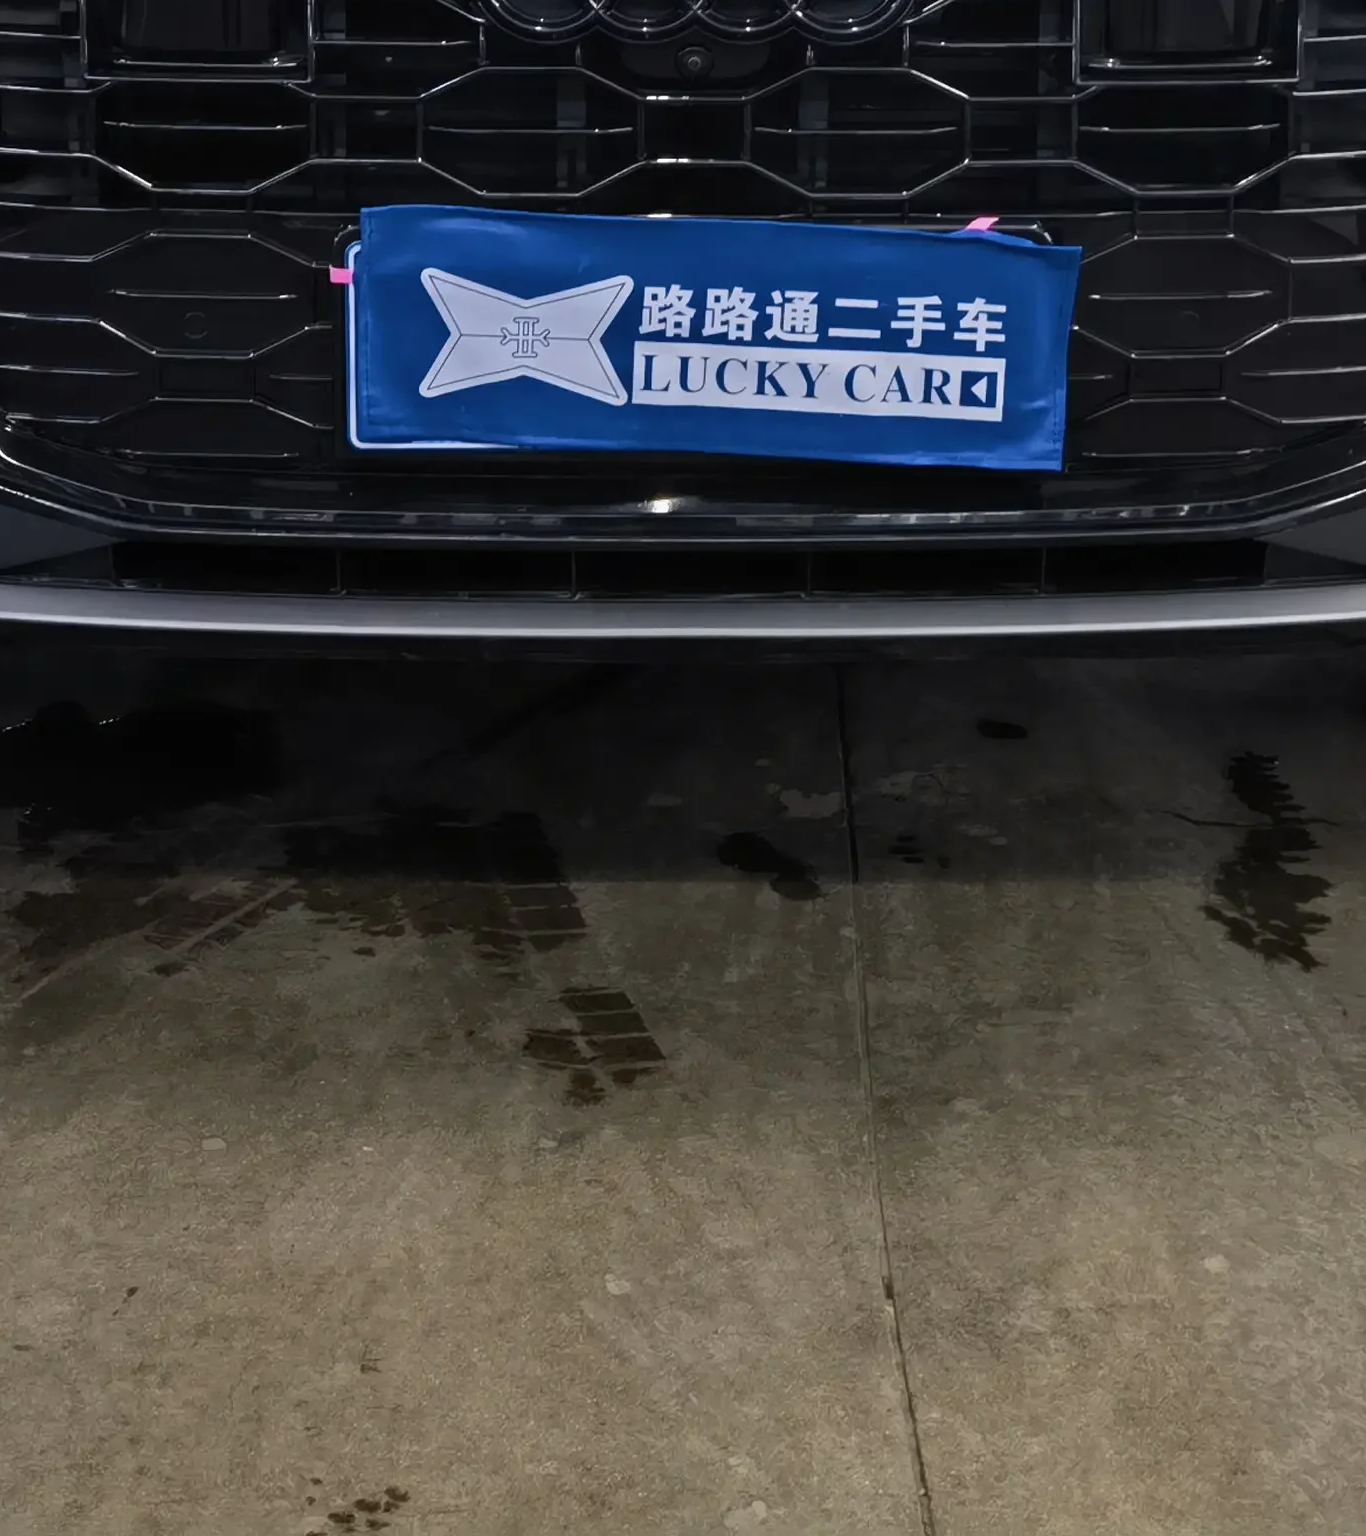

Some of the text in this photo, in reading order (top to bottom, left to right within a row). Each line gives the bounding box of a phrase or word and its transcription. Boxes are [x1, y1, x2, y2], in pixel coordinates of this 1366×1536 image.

[638, 284, 1007, 352] 路路通二手车
[639, 354, 953, 406] LUCKY CAR
